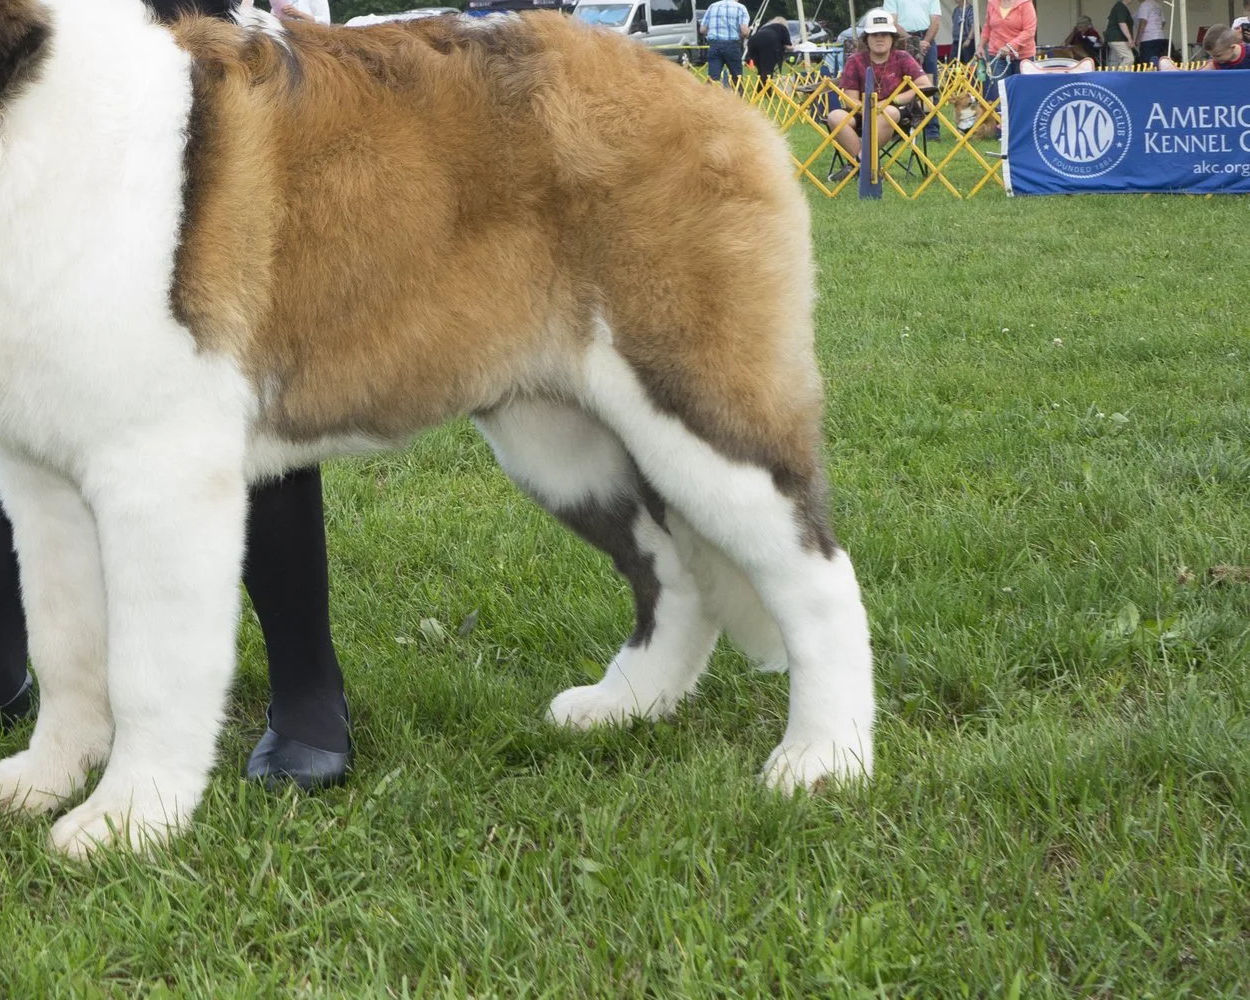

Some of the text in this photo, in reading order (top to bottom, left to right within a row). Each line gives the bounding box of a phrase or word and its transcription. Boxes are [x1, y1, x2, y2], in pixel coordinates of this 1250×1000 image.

[1038, 88, 1126, 139] AMERICAN KENNEL CLUB
[1053, 102, 1111, 161] AKC
[1144, 132, 1233, 154] KENNEL
[1052, 157, 1092, 173] FOUNDED
[1192, 160, 1250, 177] akc.org
